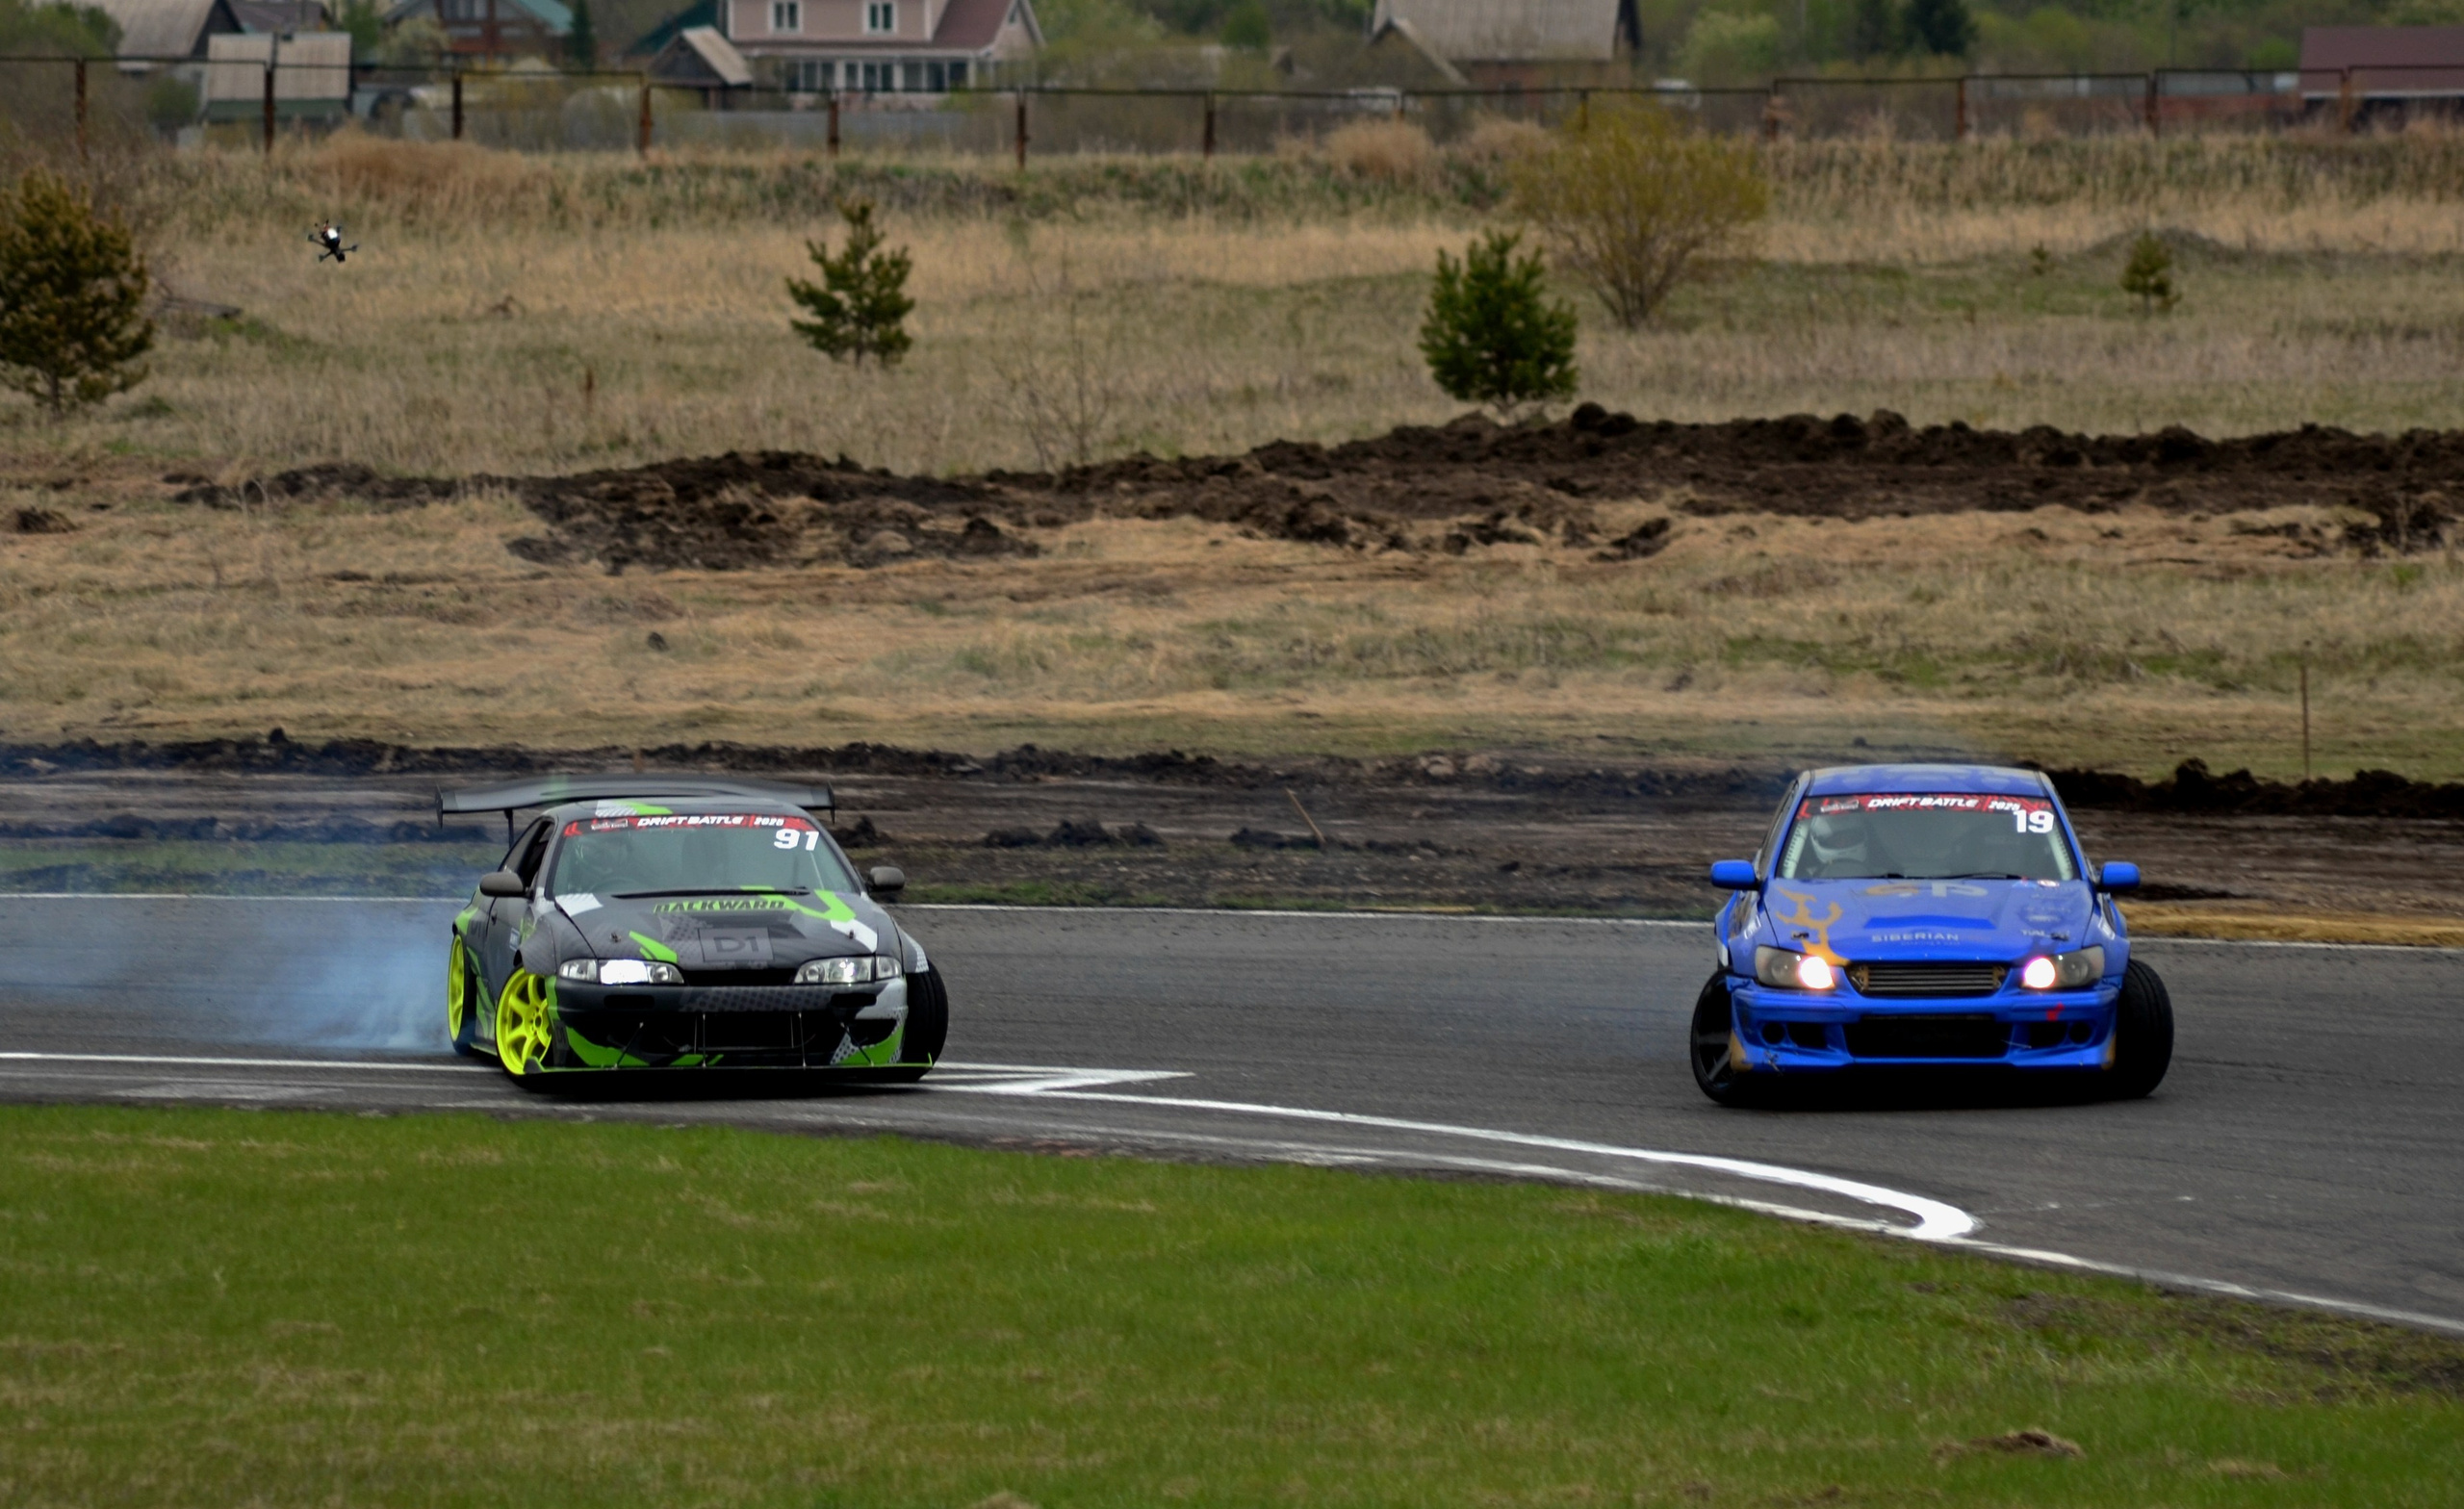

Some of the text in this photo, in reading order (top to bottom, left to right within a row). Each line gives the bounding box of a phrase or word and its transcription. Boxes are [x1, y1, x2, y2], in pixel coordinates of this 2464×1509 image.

[1868, 797, 1921, 808] DRIFT
[1919, 797, 1980, 808] BATTLE
[637, 816, 689, 827] DRIFT
[687, 815, 744, 825] BATTLE
[2013, 809, 2055, 834] 19
[774, 828, 820, 852] 91
[713, 935, 759, 953] D1
[1872, 932, 1960, 942] SIBERIAN
